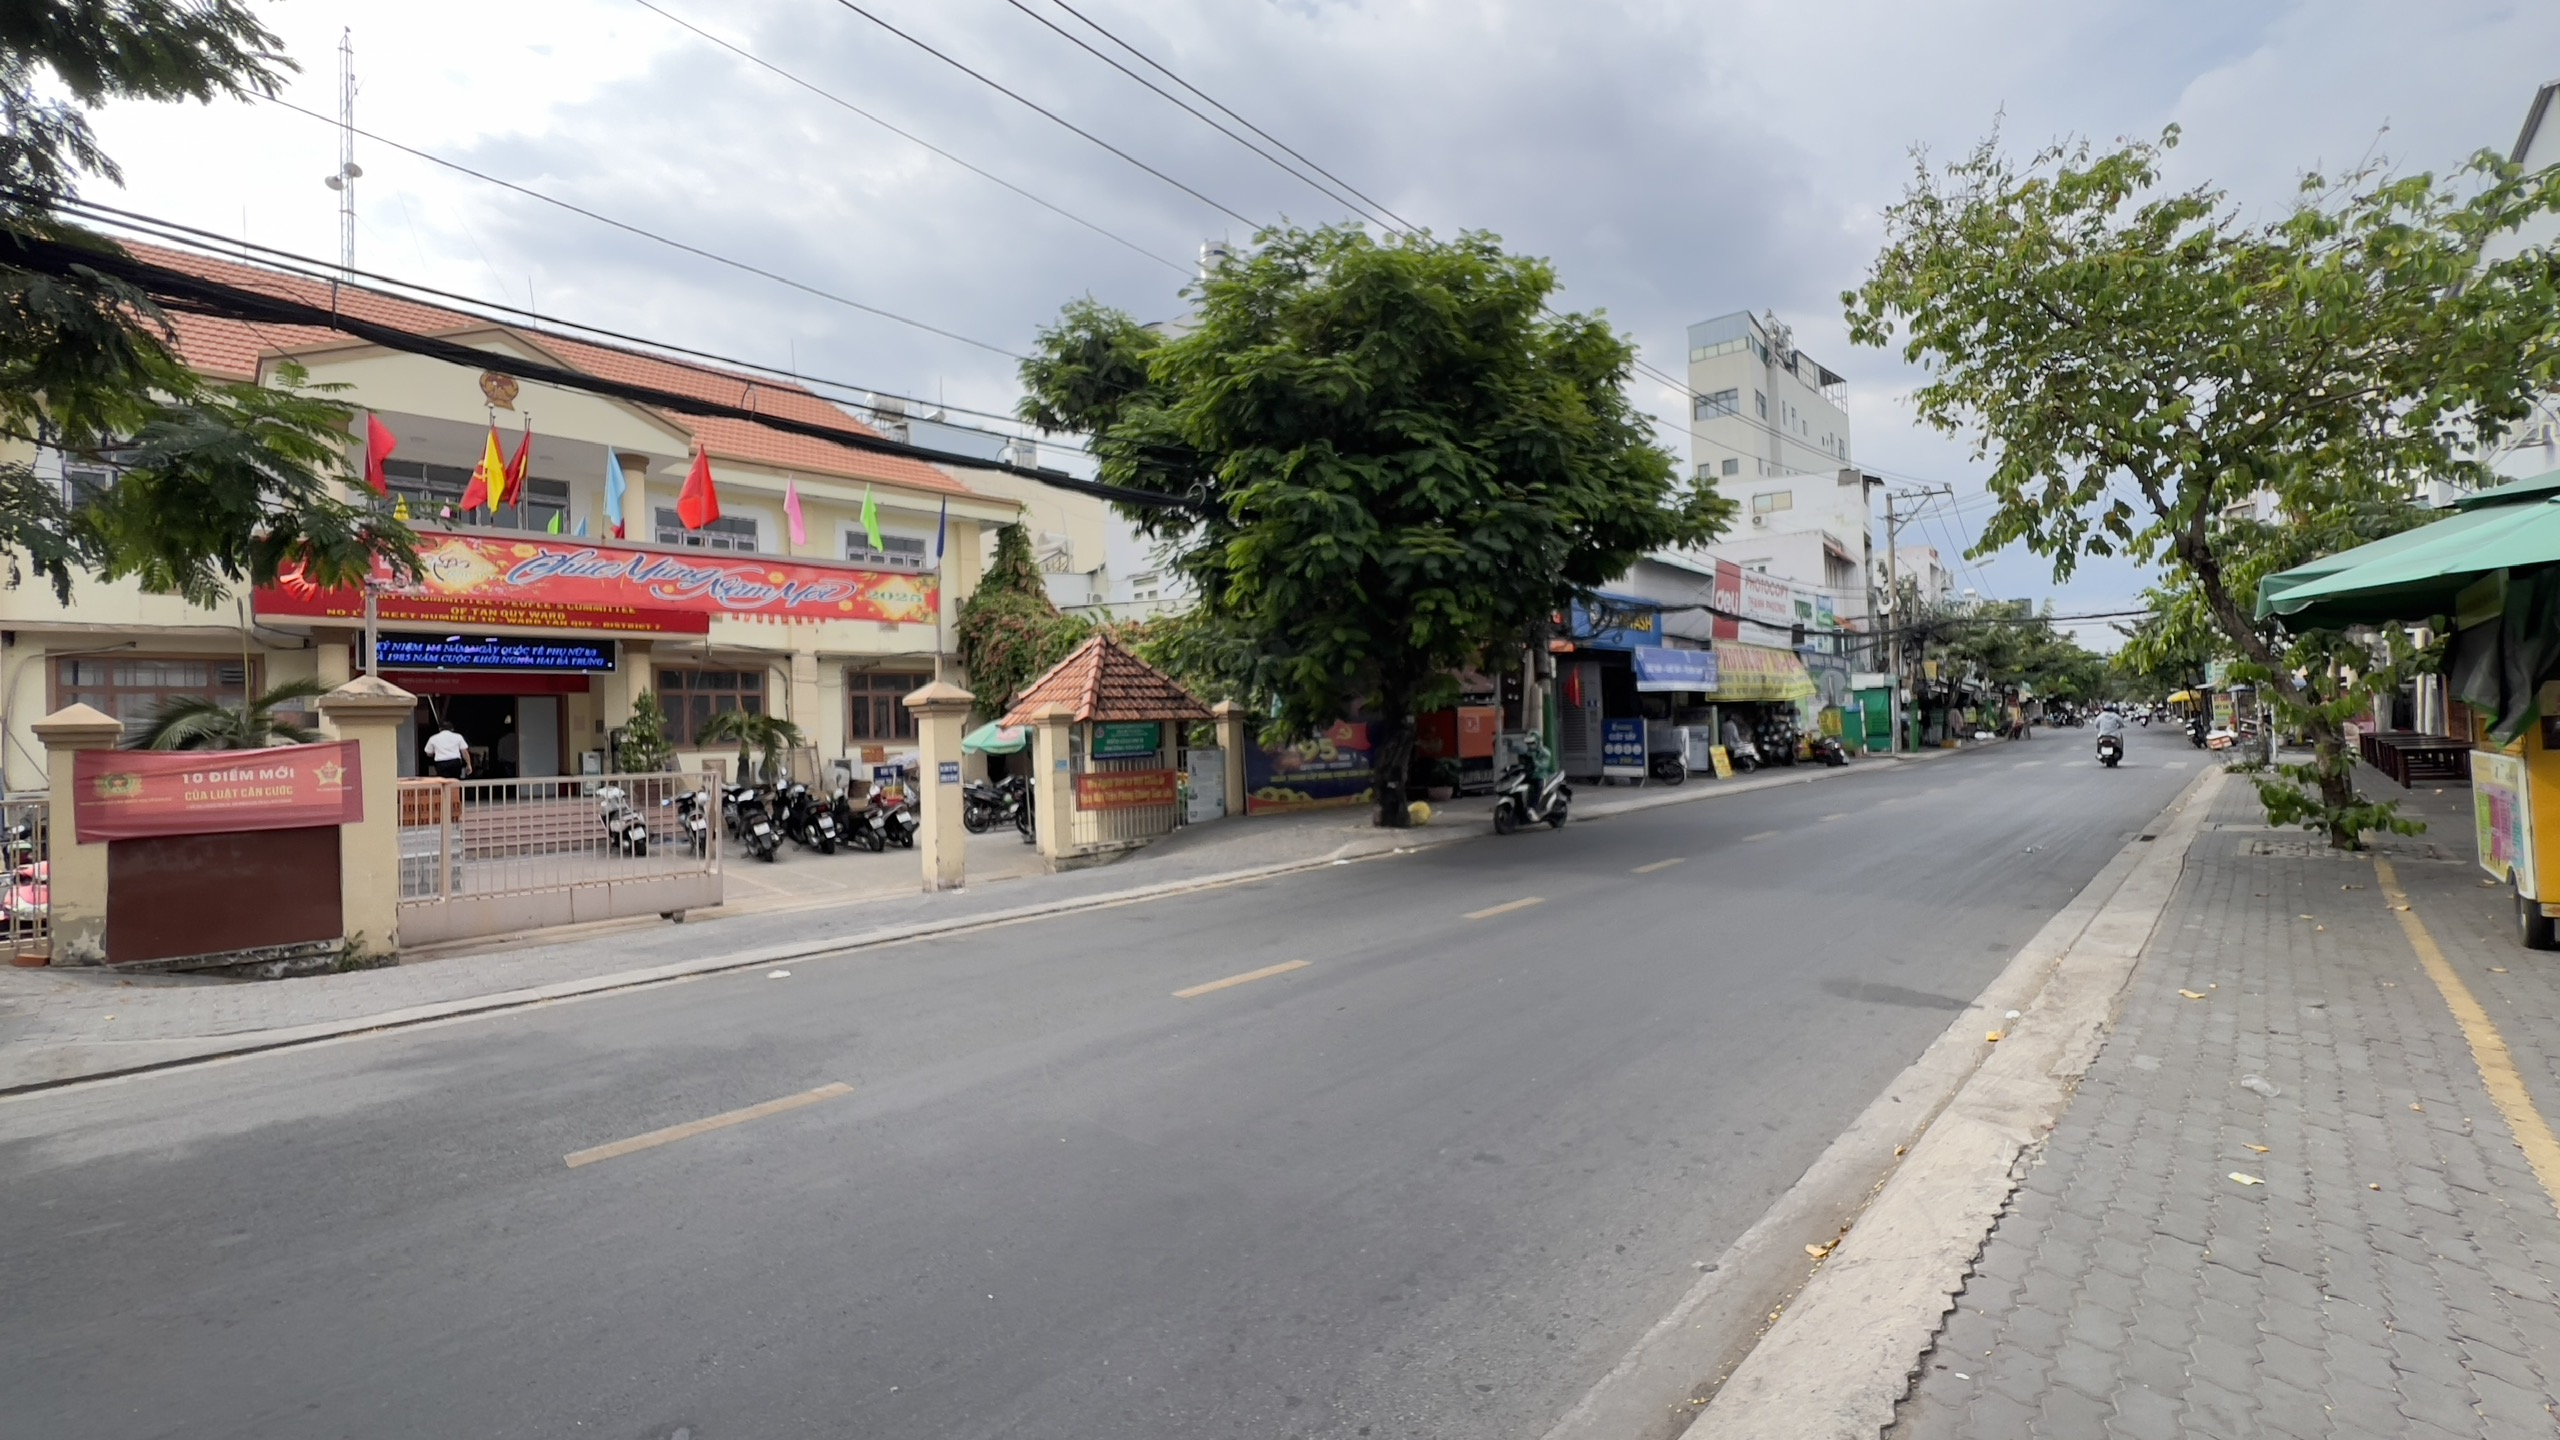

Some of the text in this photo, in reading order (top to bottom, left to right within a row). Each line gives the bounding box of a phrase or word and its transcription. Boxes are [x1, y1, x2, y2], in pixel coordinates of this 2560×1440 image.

[1745, 574, 1789, 599] PHOTOCOPY
[866, 590, 923, 603] 2025
[1715, 588, 1739, 615] deli
[451, 606, 566, 620] OF TAN QUY WARD
[566, 603, 636, 614] COMMITTEE
[420, 613, 476, 622] NUMBER
[507, 617, 541, 625] WARD
[545, 619, 567, 627] TAN
[571, 620, 592, 628] QUY
[603, 622, 647, 630] DISTRICT
[392, 642, 422, 653] NIỆM
[501, 645, 530, 656] QUỐC
[387, 653, 411, 662] 1985
[412, 652, 439, 663] NĂM
[441, 654, 471, 664] CUỘC
[473, 654, 499, 664] KHỞI
[536, 657, 554, 666] HAI
[556, 656, 569, 666] BÀ
[1298, 738, 1338, 761] 95
[182, 765, 295, 784] 10 ĐIỂM MỚI
[185, 788, 208, 802] CỦA
[210, 787, 237, 801] LUẬT
[241, 784, 263, 798] CĂN
